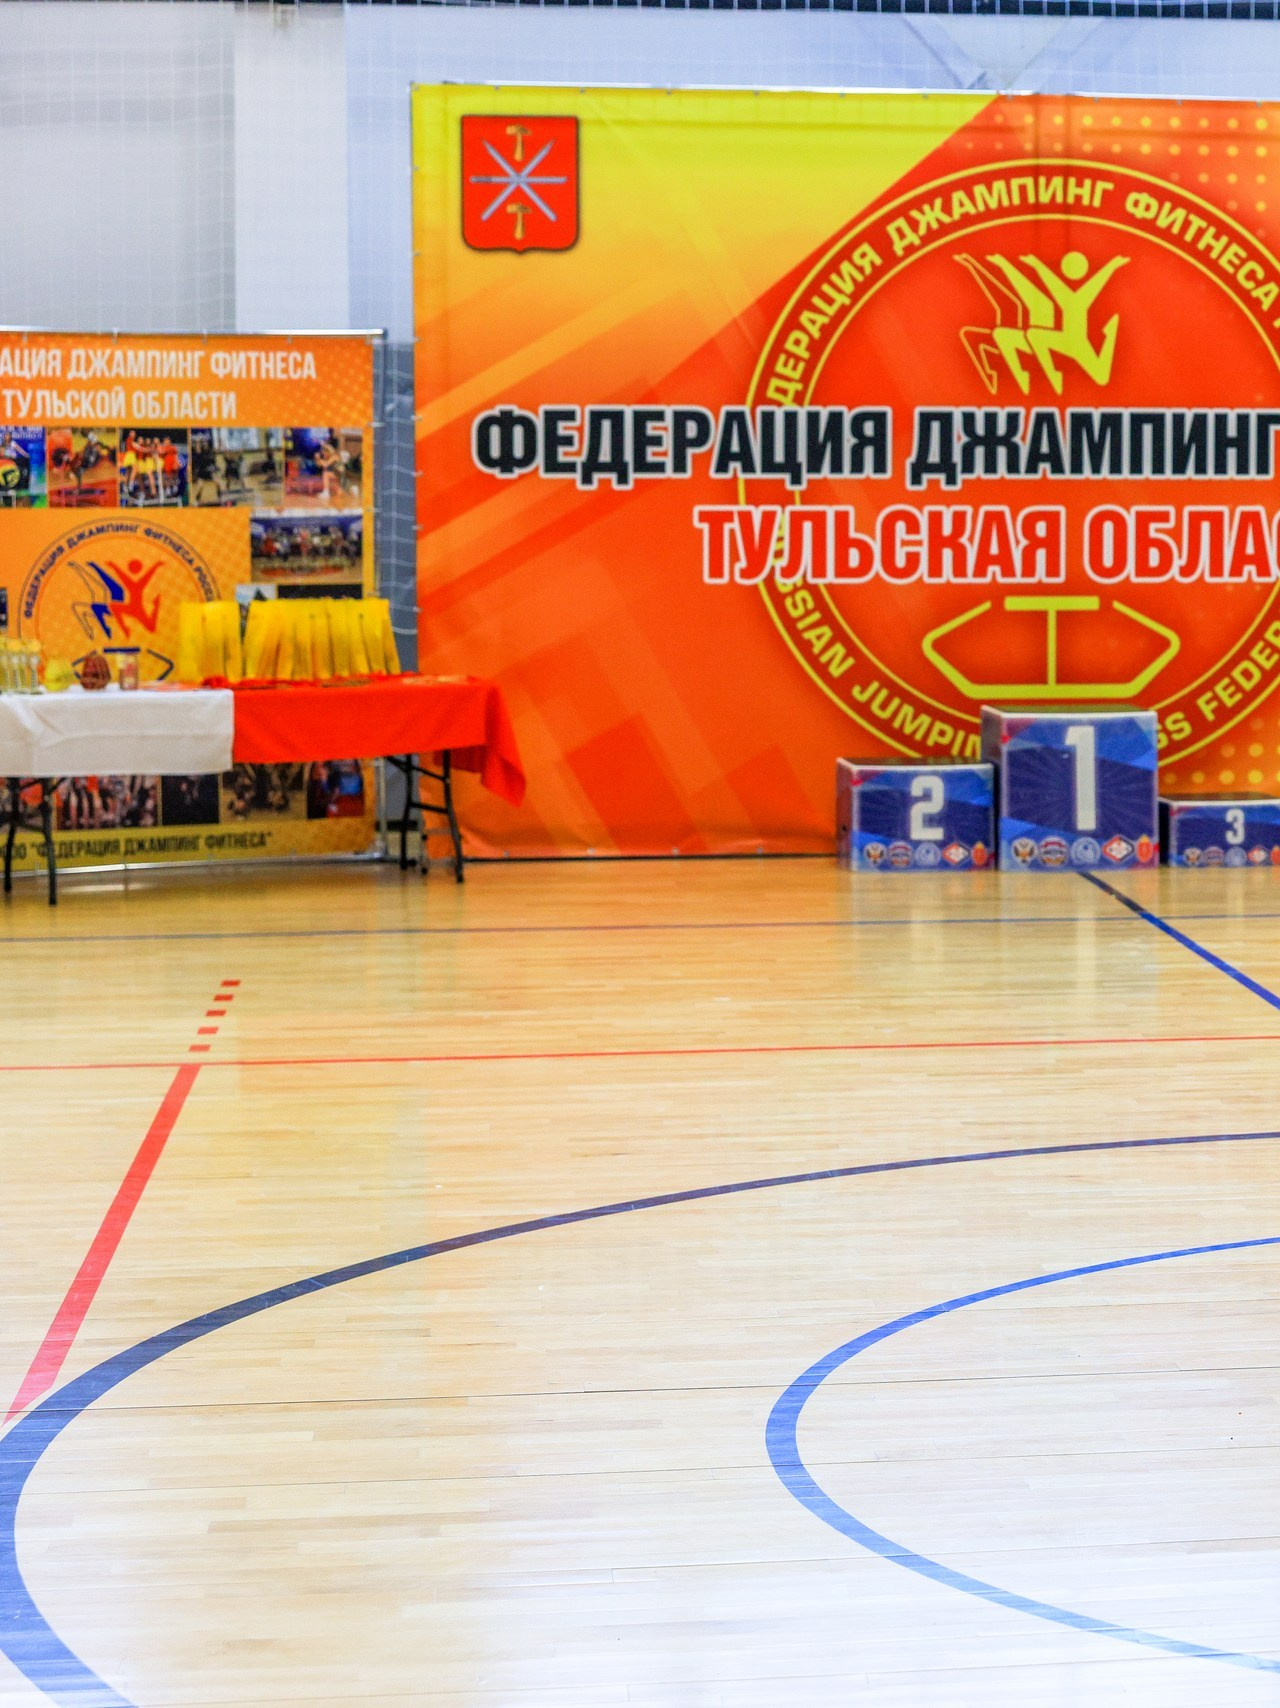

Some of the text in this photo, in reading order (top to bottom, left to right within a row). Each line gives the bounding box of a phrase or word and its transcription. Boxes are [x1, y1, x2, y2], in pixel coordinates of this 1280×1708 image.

[766, 242, 882, 407] ДЕРАЦИЯ
[886, 176, 1115, 256] ДЖАМПИНГ
[1125, 192, 1280, 311] ФИТНЕСА
[2, 386, 237, 420] ТУЛЬСКОЙ ОБЛАСТИ
[67, 348, 204, 380] ДЖАМПИНГ
[210, 351, 317, 380] ФИТНЕСА
[472, 404, 889, 491] ФЕДЕРАЦИЯ
[693, 505, 1063, 584] ТУЛЬСКАЯ
[851, 680, 981, 760] JUMPIN
[909, 775, 945, 841] 2
[1064, 725, 1097, 831] 1
[1224, 809, 1246, 845] 3
